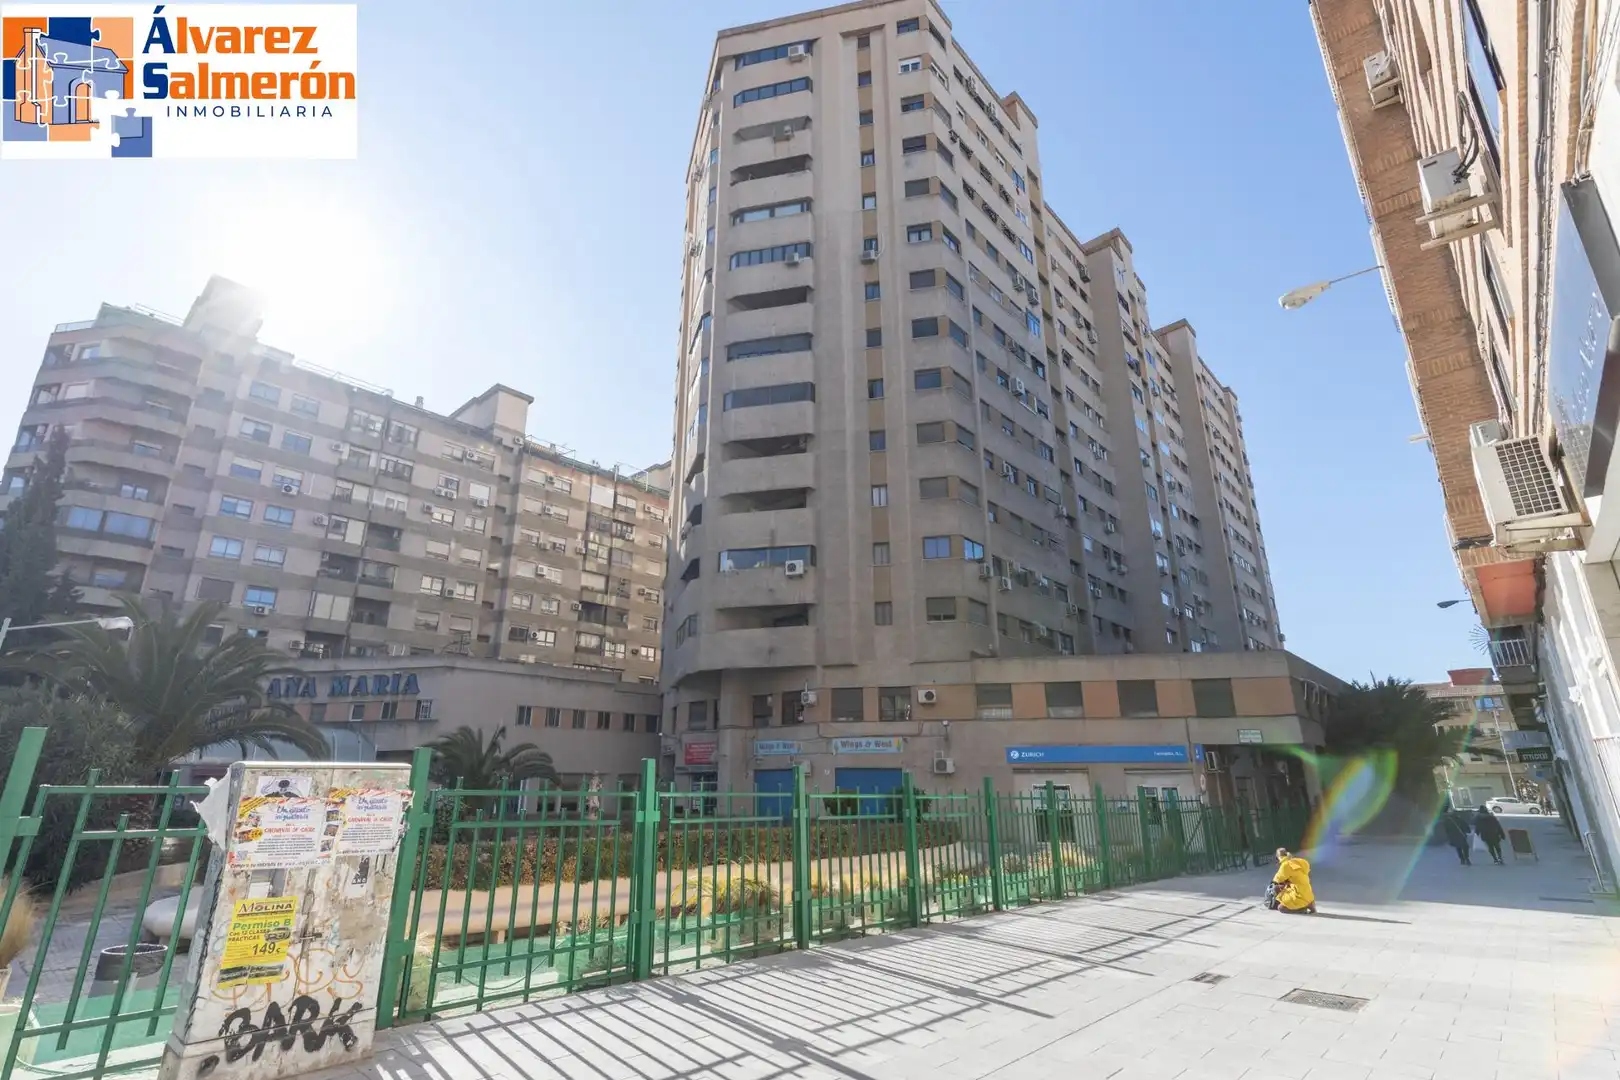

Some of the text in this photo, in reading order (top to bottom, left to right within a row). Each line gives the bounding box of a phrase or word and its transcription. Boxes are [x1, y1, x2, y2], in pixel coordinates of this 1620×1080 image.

[238, 902, 293, 914] MOLINA
[232, 918, 292, 931] Permiso B
